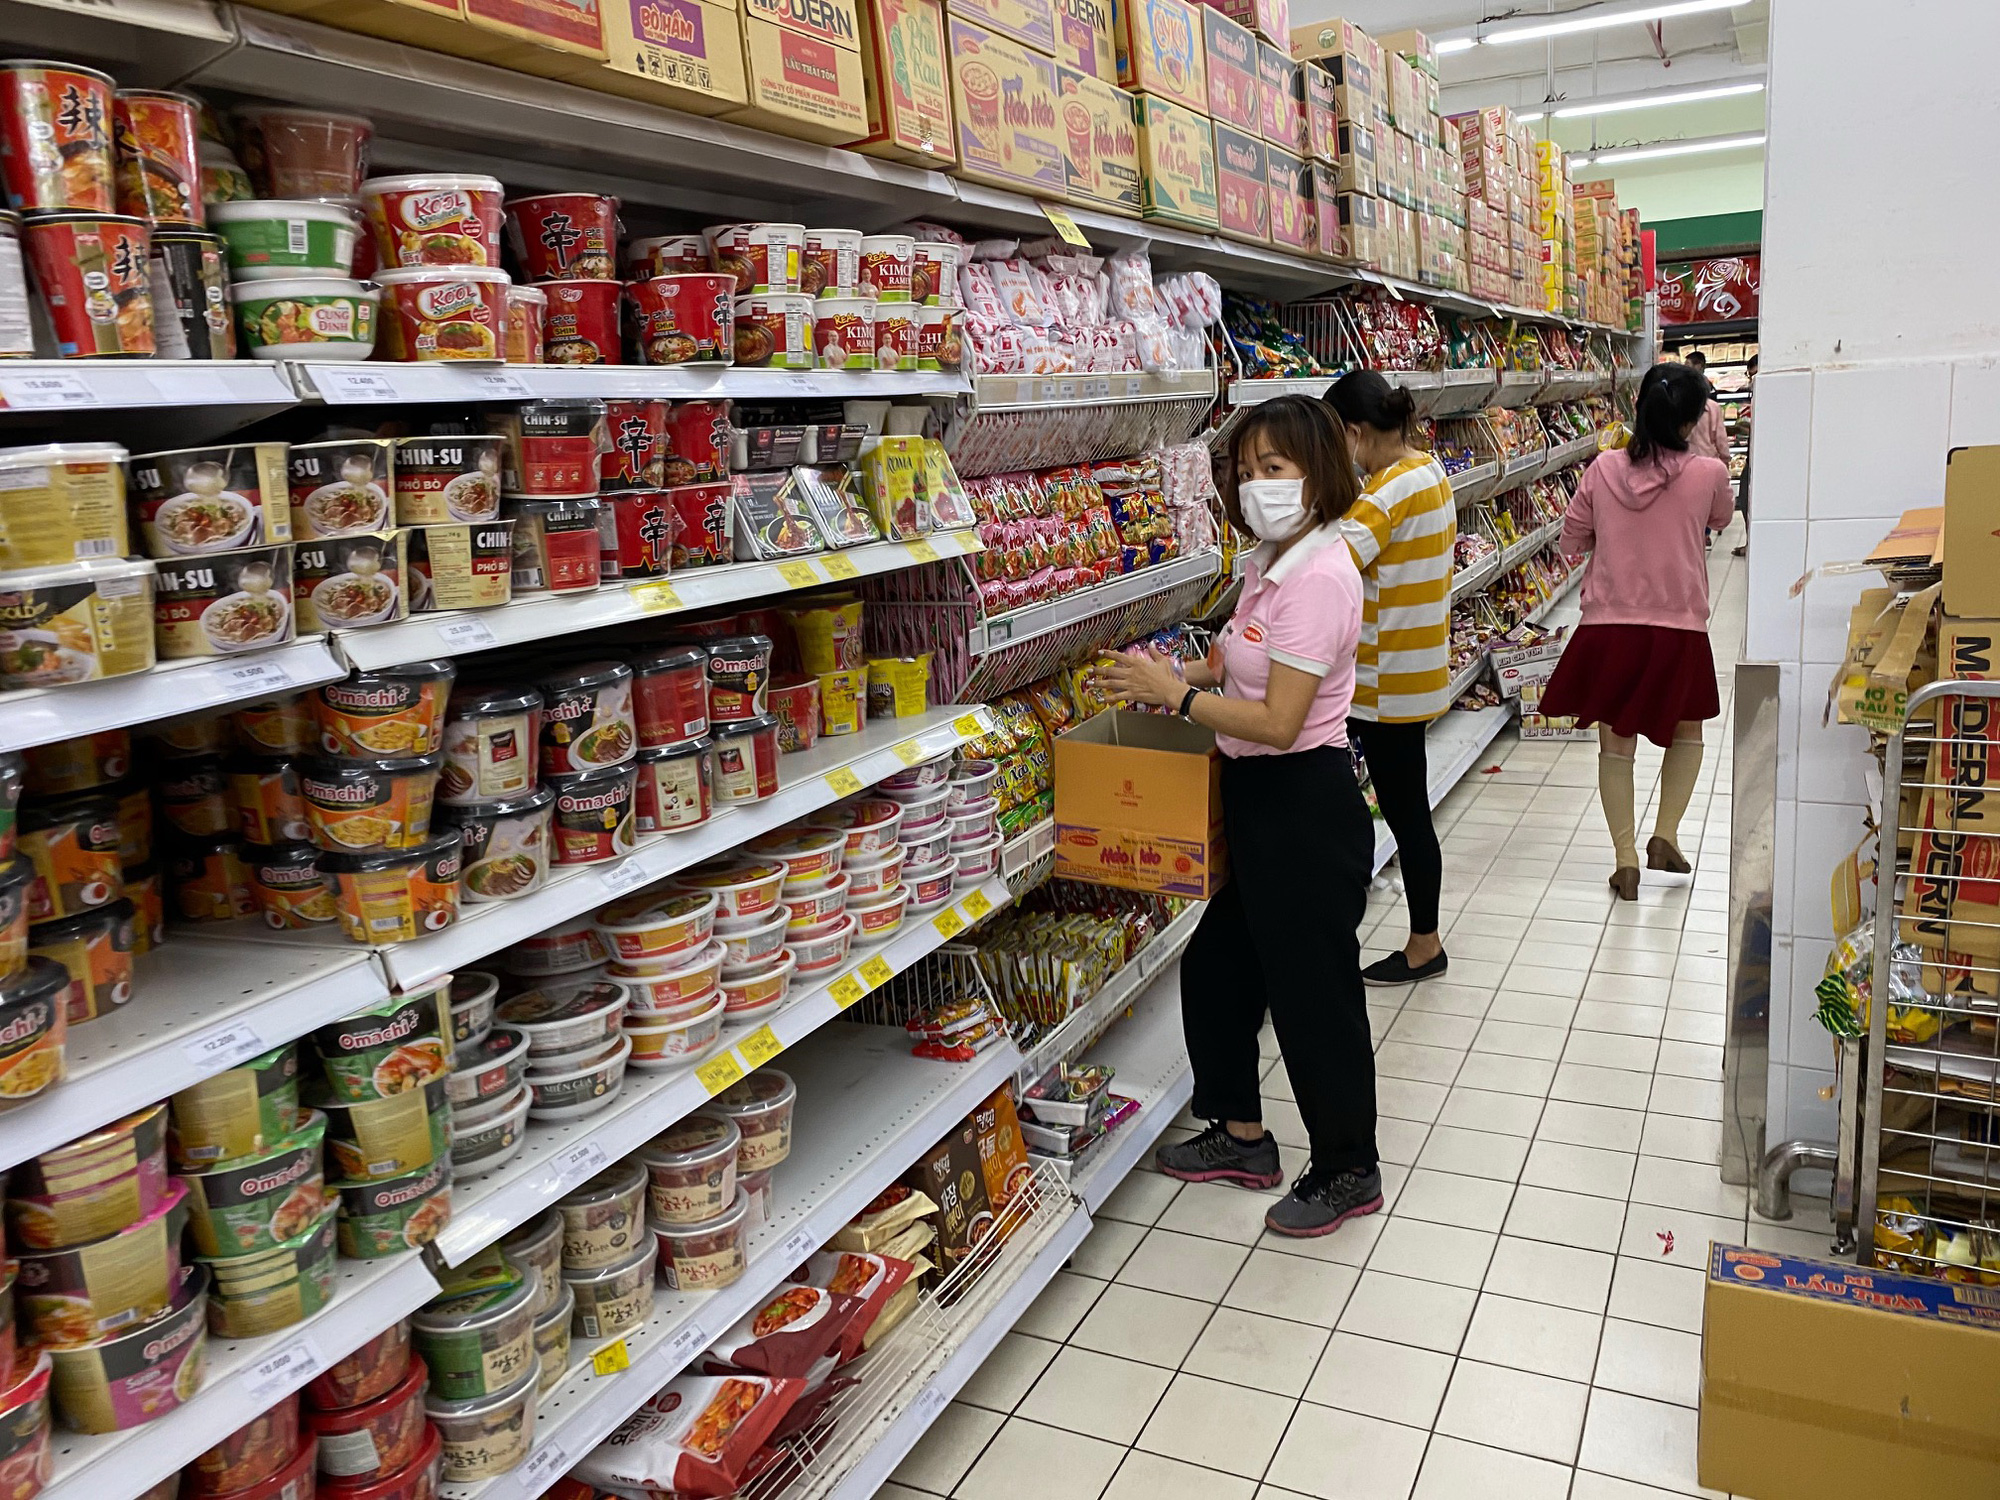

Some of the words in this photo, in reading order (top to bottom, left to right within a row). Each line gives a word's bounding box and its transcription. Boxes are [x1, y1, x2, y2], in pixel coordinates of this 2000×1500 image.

[640, 3, 660, 30] BÒ
[413, 192, 465, 219] KOOL
[541, 211, 581, 268] 辛
[866, 252, 890, 264] REAL
[429, 286, 477, 309] KOOL
[561, 288, 582, 301] Big
[658, 284, 680, 297] Big
[315, 309, 350, 320] CUNG
[712, 290, 735, 345] 辛
[833, 313, 857, 325] REAL
[555, 327, 576, 335] SHIN
[655, 321, 675, 330] SHIN
[524, 414, 568, 426] CHIN-SU
[617, 415, 654, 473] 辛
[709, 413, 729, 468] 辛
[423, 477, 441, 490] BÒ
[547, 510, 585, 522] CHIN-SU
[703, 497, 726, 551] 辛
[640, 506, 669, 561] 辛
[710, 655, 765, 673] Omachi
[325, 685, 398, 707] Omachi
[1855, 700, 1888, 714] RAU
[1950, 636, 1992, 820] MDERN
[303, 778, 367, 801] Omachi
[558, 784, 626, 813] Omachi
[740, 898, 761, 907] VIFON
[866, 920, 883, 928] VIFON
[657, 990, 679, 1000] VIFON
[339, 1018, 411, 1051] Omachi
[241, 1160, 311, 1195] Omachi
